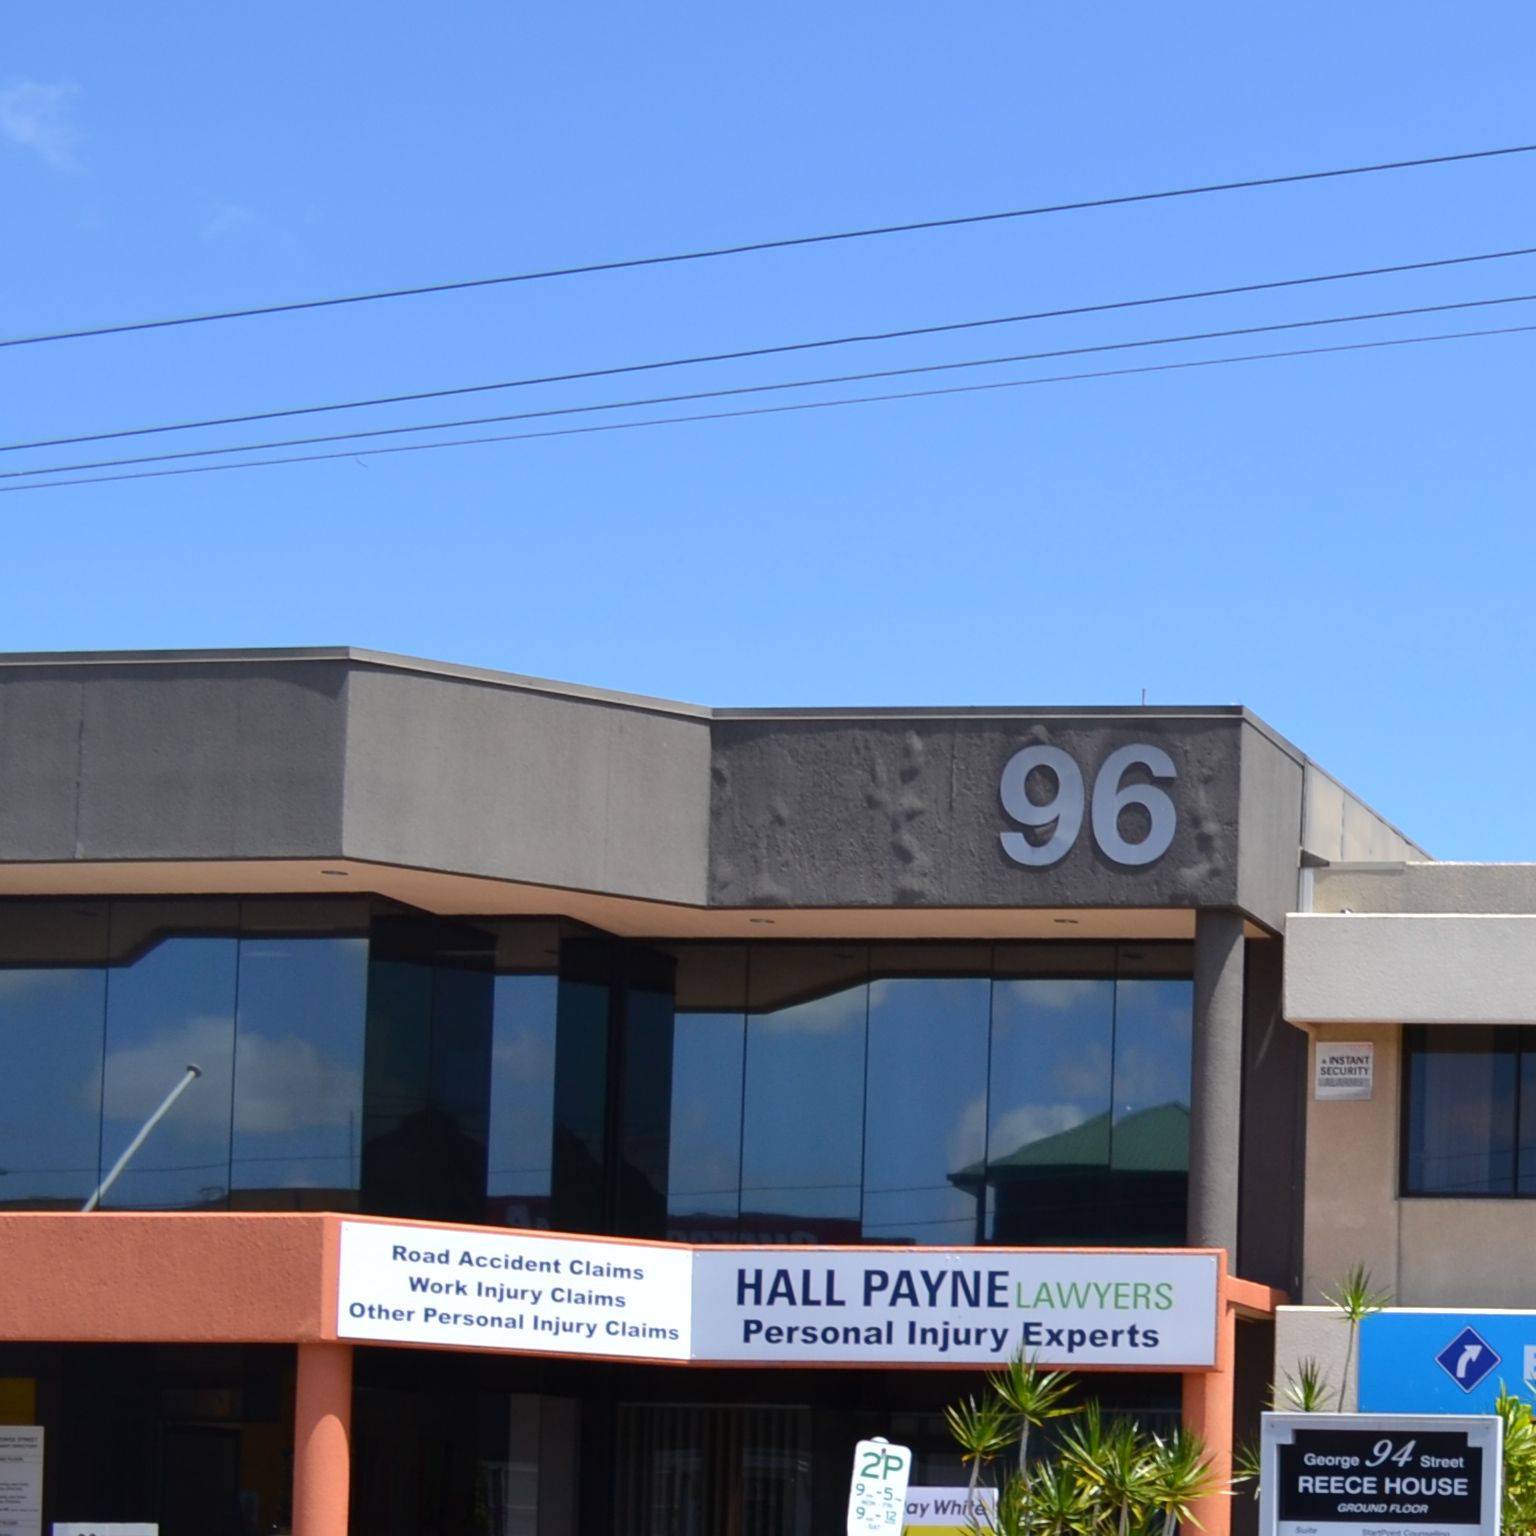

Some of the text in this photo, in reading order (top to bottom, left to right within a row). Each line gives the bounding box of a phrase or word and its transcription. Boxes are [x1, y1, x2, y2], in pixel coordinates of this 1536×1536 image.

[1000, 743, 1177, 866] 96
[1320, 1066, 1369, 1076] SECURITY
[391, 1244, 645, 1281] Road Accident Claims
[408, 1276, 627, 1308] Work Injury Claims
[736, 1268, 1174, 1312] HALL PAYNE LAWYERS
[348, 1302, 680, 1341] Other Personal Injury Claims
[742, 1319, 1160, 1354] Personal Injury Experts
[860, 1452, 904, 1480] 2P
[1303, 1439, 1464, 1469] George 94 Street
[1298, 1476, 1469, 1496] REECE HOUSE
[903, 1502, 929, 1518] ay
[1337, 1503, 1429, 1514] GROUND FLOOR
